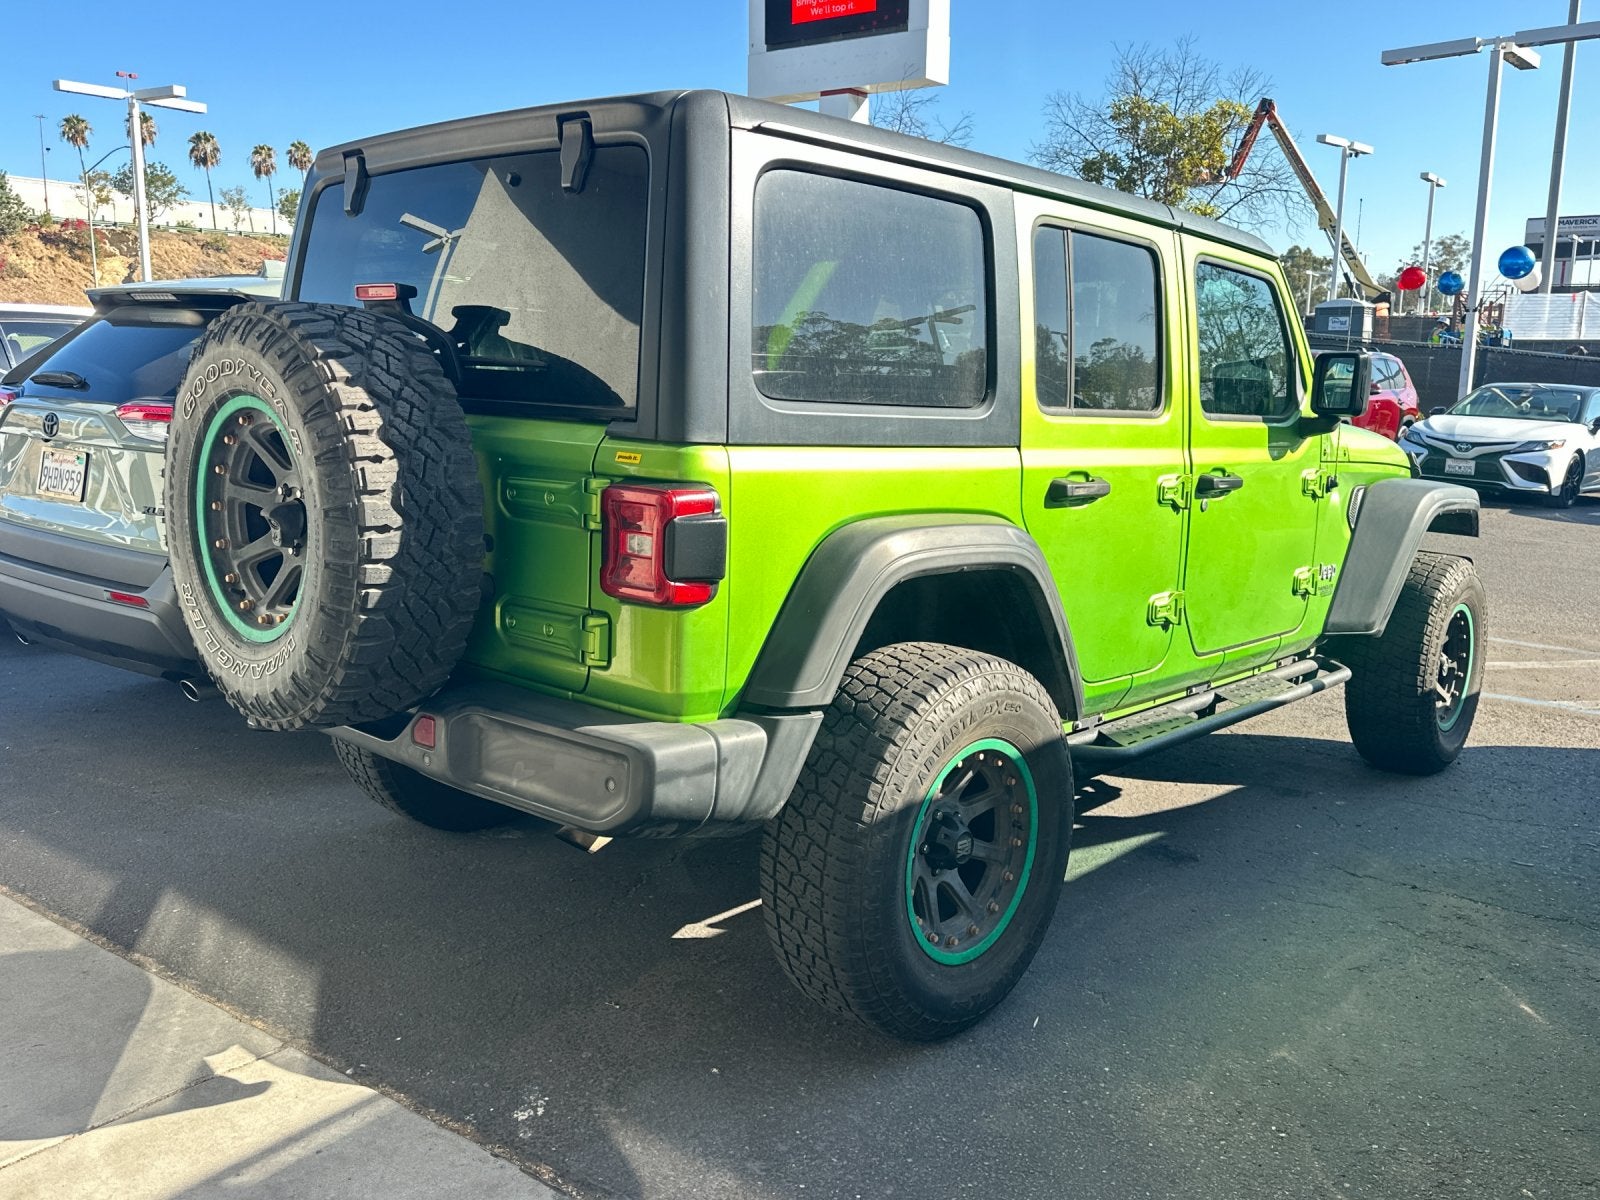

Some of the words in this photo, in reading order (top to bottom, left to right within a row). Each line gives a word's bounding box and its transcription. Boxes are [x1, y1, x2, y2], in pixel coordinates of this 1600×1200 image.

[811, 5, 830, 15] We'll
[832, 4, 846, 13] top
[1558, 218, 1598, 226] MAVERICK
[183, 358, 303, 456] GOODYEAR
[41, 465, 82, 494] 9HBN959
[182, 583, 296, 679] WRANGLER
